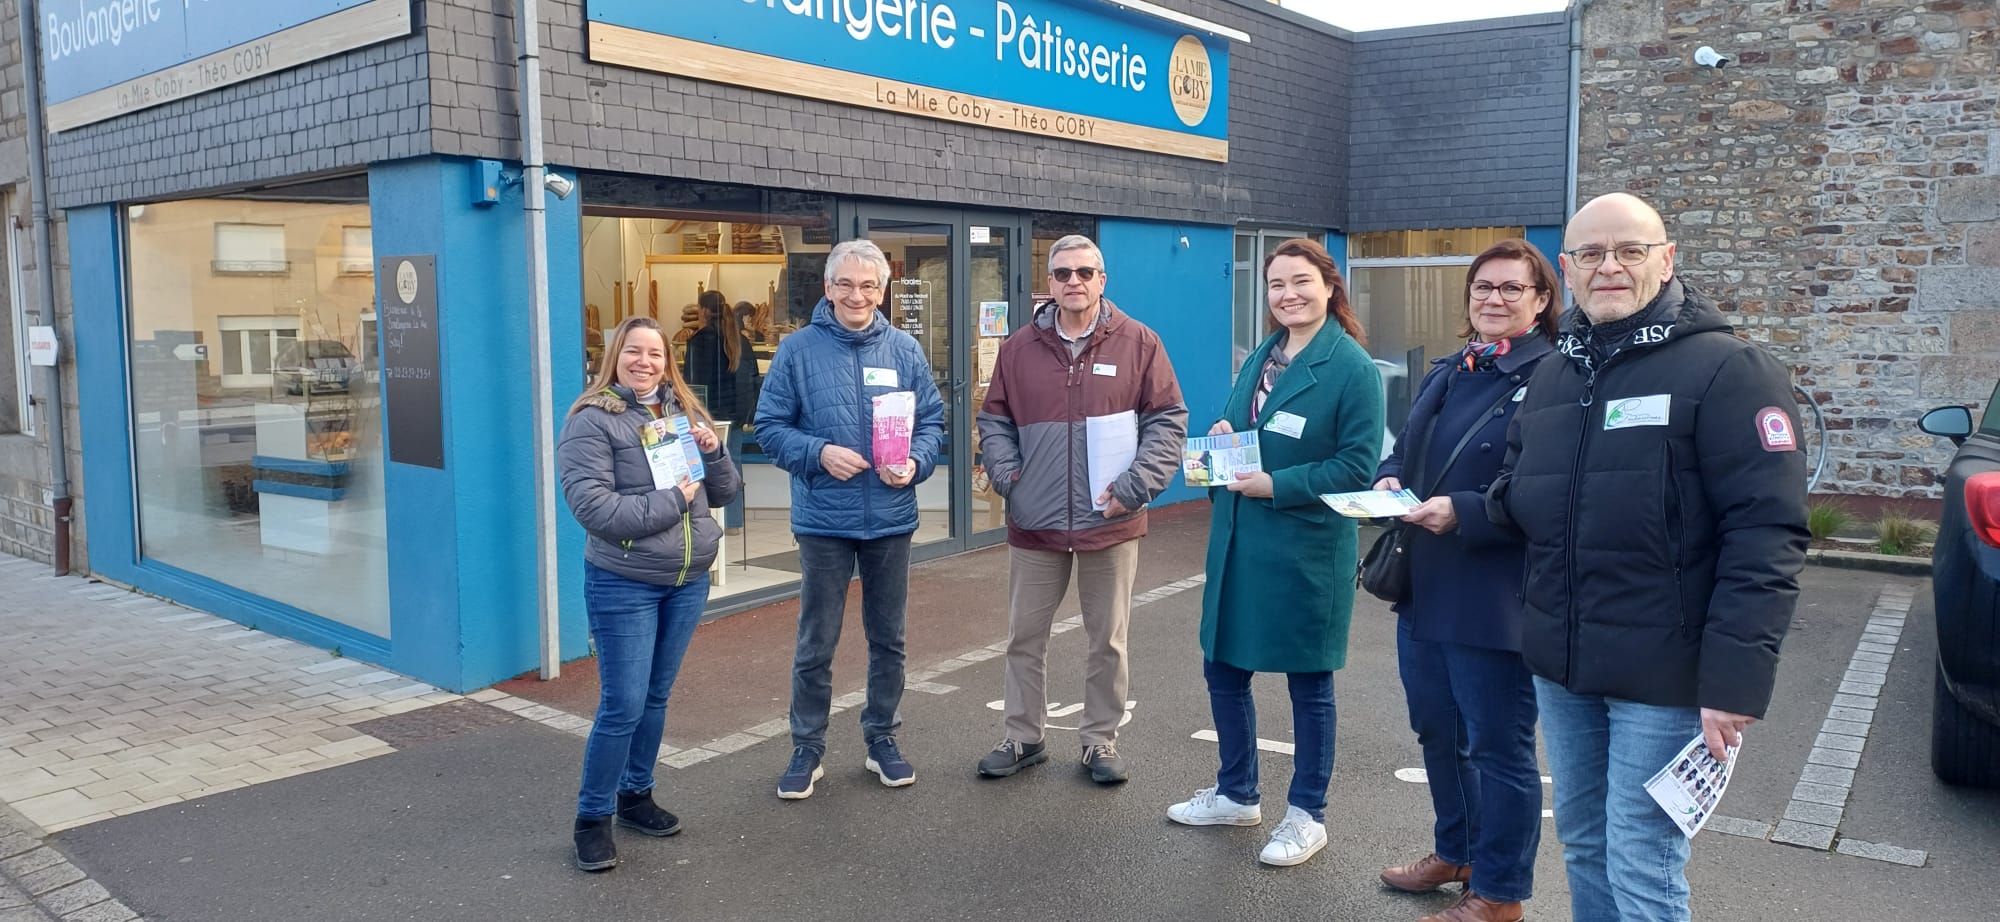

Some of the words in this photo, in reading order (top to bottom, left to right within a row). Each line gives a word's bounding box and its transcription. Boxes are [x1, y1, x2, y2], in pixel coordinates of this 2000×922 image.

[116, 90, 128, 109] La
[154, 74, 183, 98] Goby
[199, 63, 227, 86] Théo
[233, 41, 272, 76] GOBY
[996, 0, 1147, 92] Pâtisserie
[875, 82, 896, 104] La
[906, 87, 937, 112] Mie
[947, 96, 991, 124] Goby
[1012, 107, 1048, 131] Théo
[1055, 115, 1096, 138] GOBY
